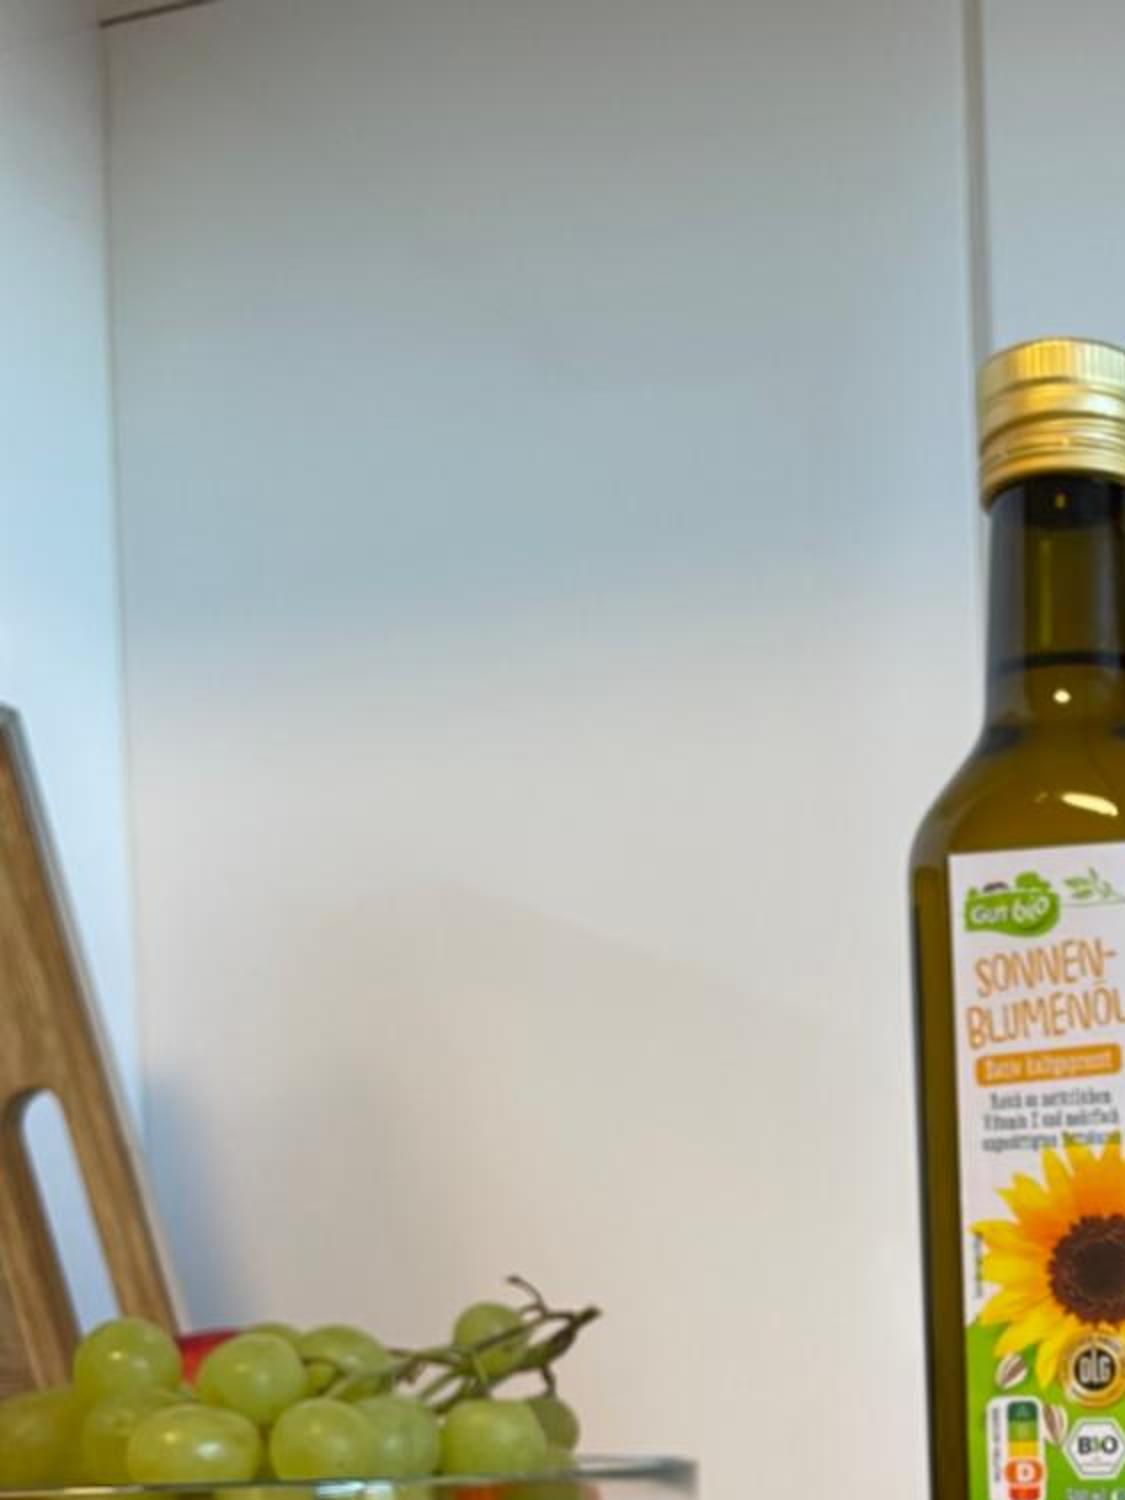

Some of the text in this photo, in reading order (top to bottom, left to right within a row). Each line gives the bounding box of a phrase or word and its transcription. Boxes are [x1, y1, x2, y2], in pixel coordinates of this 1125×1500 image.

[974, 937, 1117, 998] SONNEN-
[1077, 1435, 1119, 1455] BIO
[1015, 1460, 1034, 1482] D
